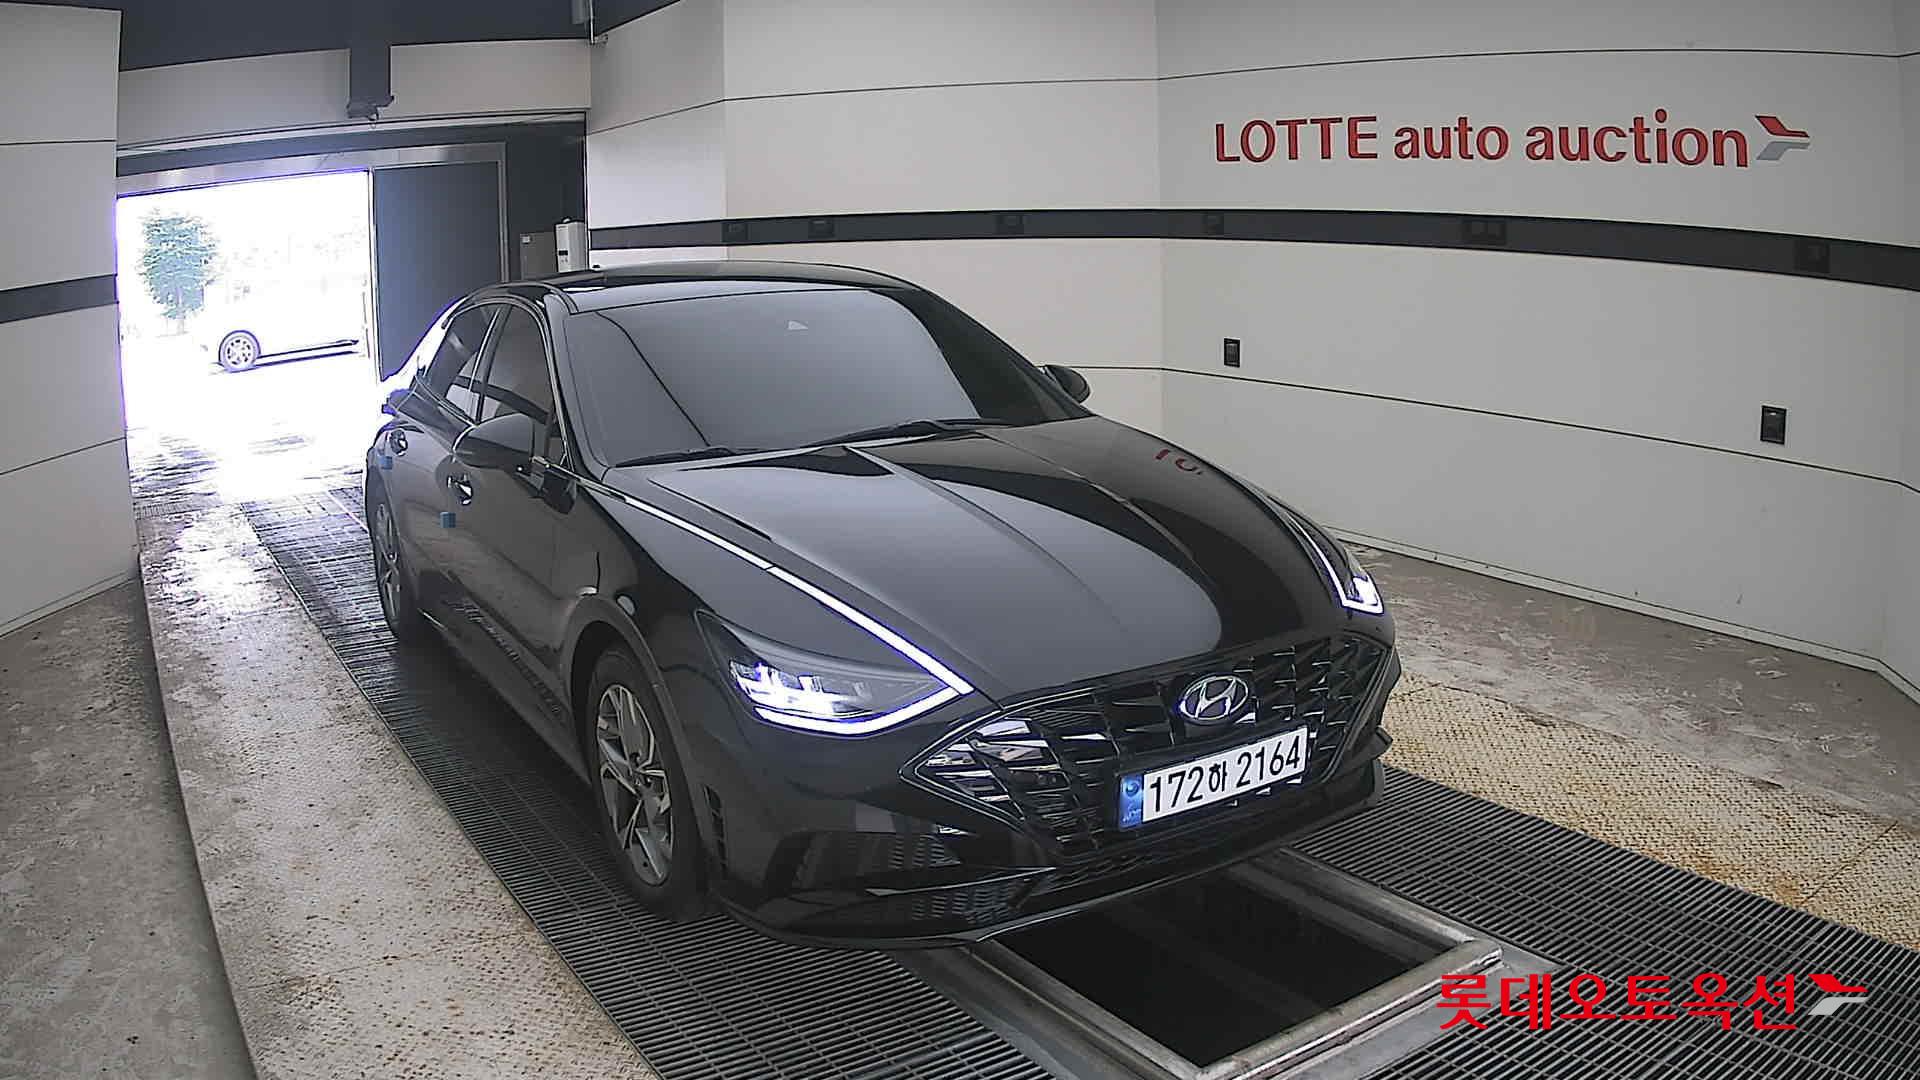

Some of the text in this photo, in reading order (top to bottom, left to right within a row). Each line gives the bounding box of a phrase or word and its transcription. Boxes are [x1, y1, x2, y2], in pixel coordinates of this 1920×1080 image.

[1214, 109, 1749, 168] LOTTE auto auction
[1150, 735, 1301, 813] 172하 2164
